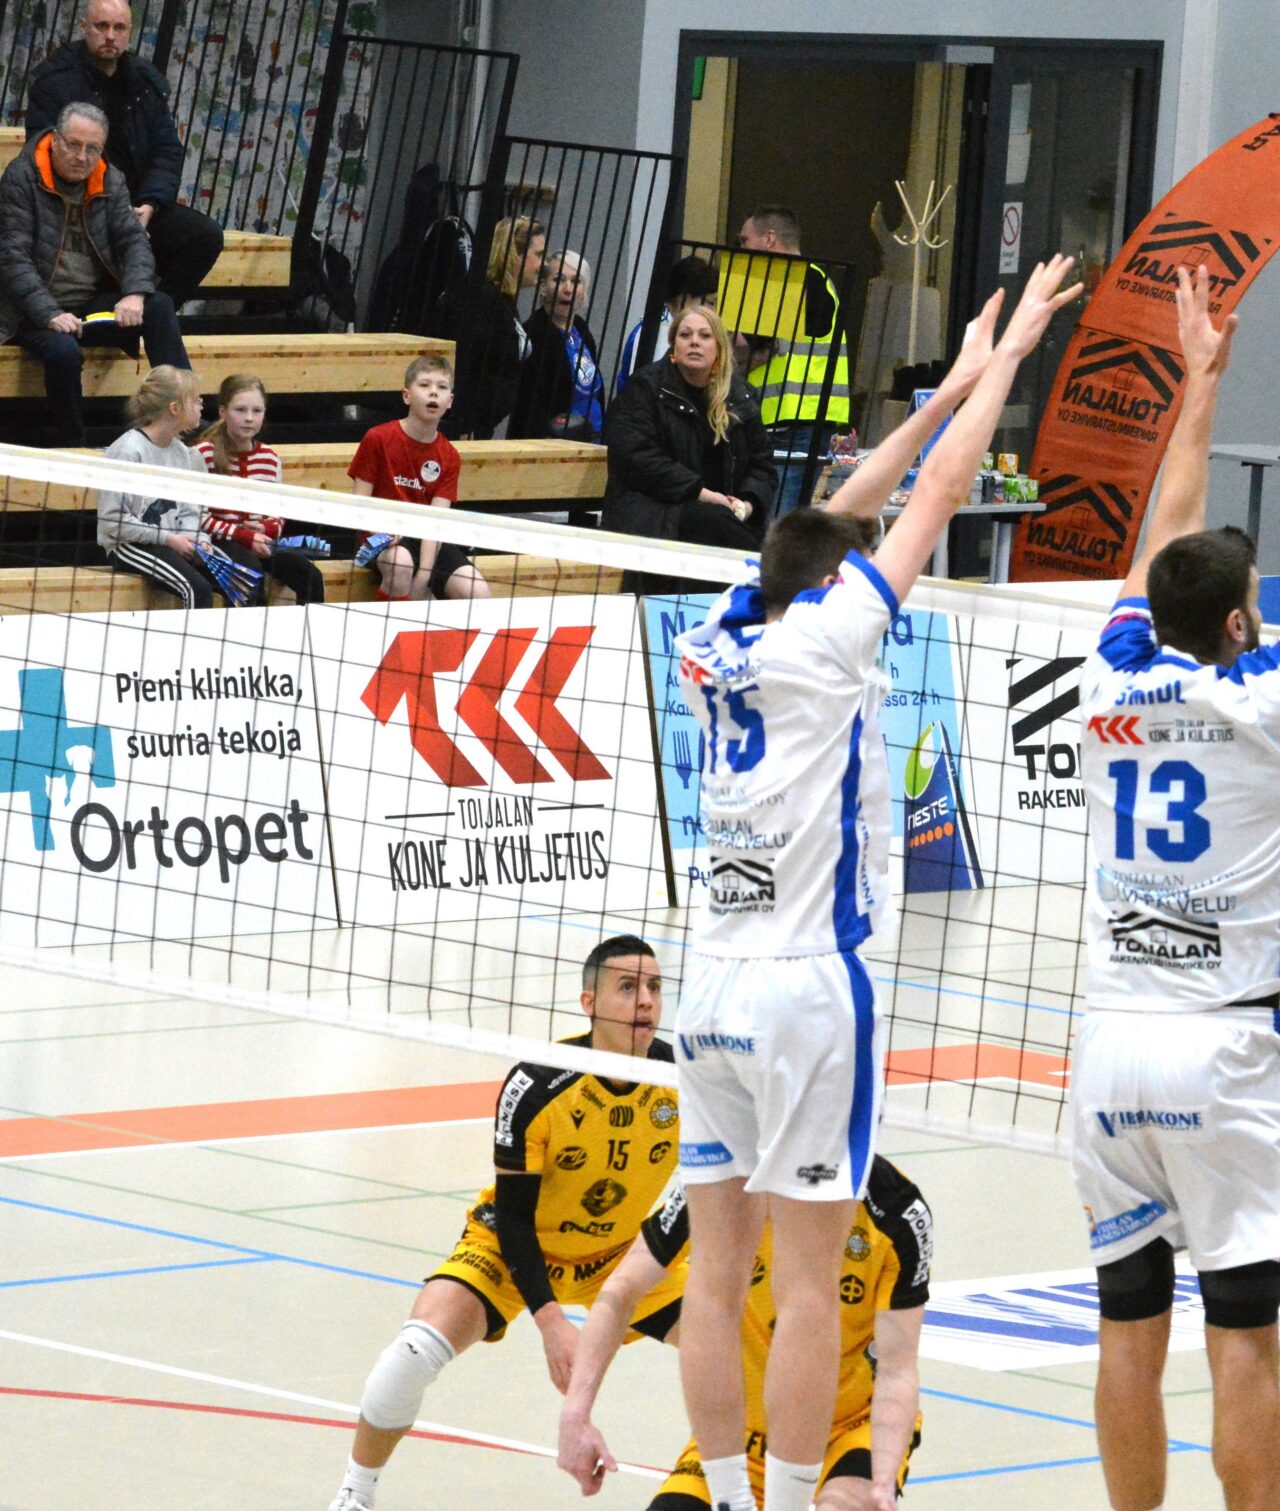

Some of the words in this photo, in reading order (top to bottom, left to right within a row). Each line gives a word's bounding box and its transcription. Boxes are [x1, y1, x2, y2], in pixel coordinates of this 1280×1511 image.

[115, 670, 182, 704] Pieni
[190, 665, 303, 702] klinikka,
[126, 729, 211, 760] suuria
[217, 723, 302, 760] tekoja
[702, 684, 765, 776] 15
[458, 797, 533, 831] TOIJALAN
[907, 795, 950, 831] NESTE
[1108, 759, 1212, 862] 13
[71, 799, 314, 884] Ortopet
[387, 839, 452, 892] KONE
[458, 836, 489, 888] JA
[495, 829, 608, 886] KULJETUS
[606, 1138, 632, 1171] 15
